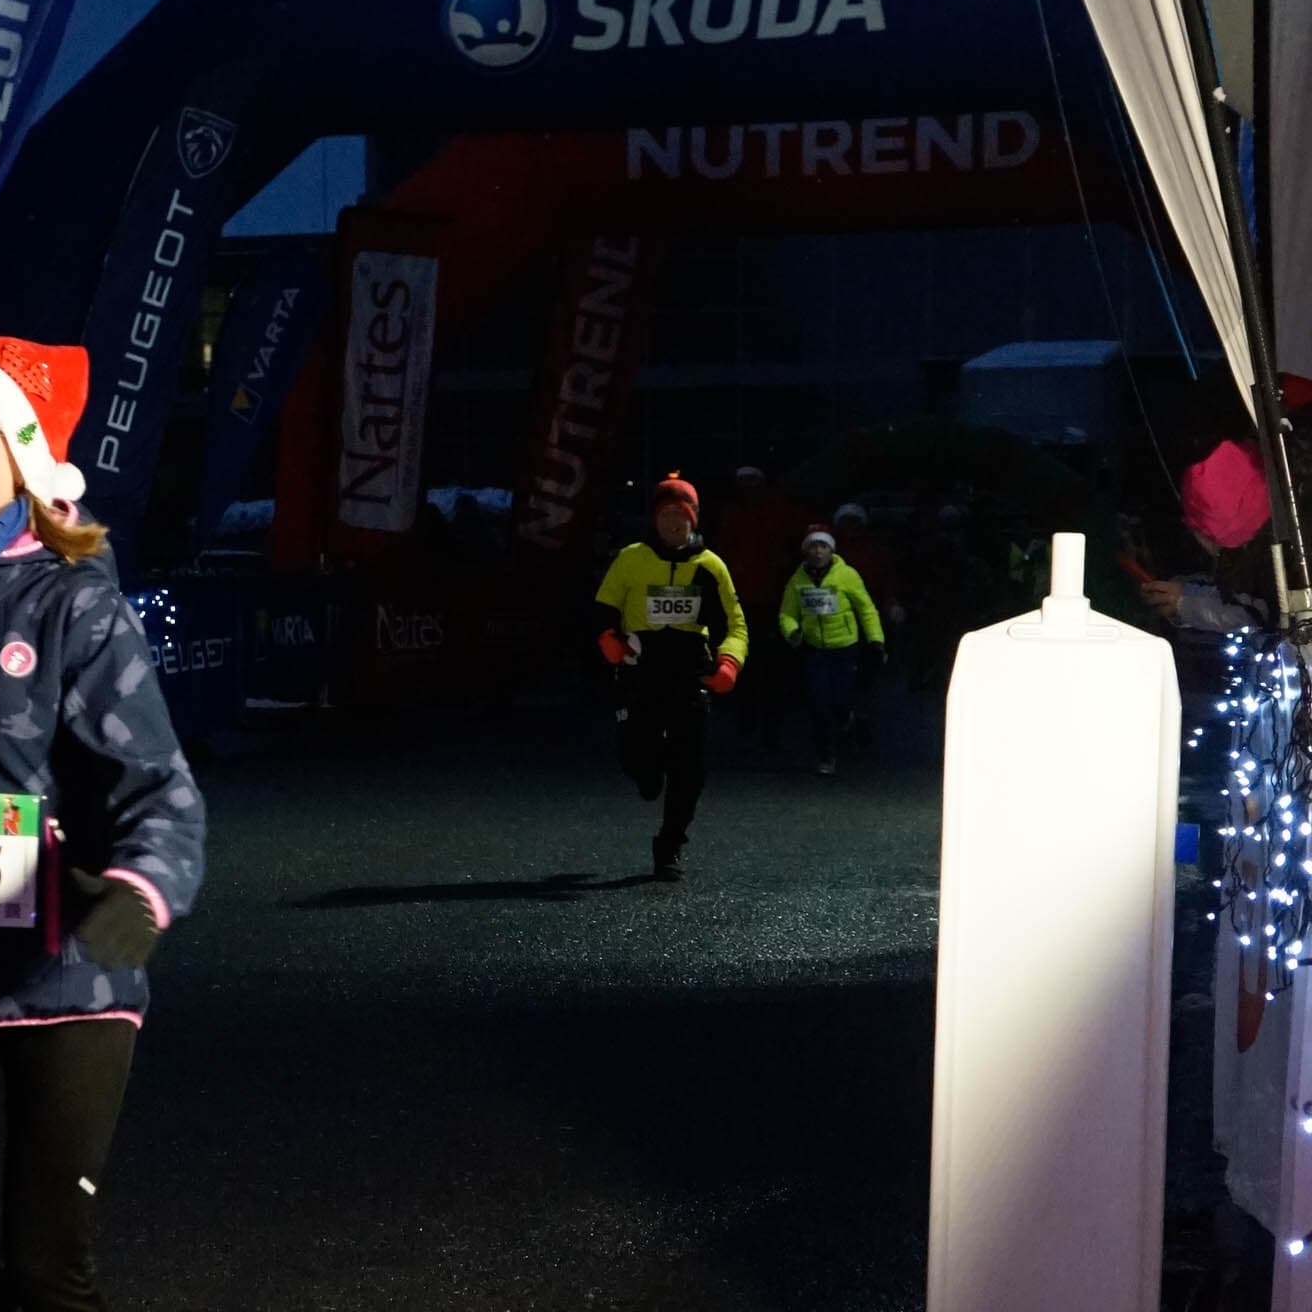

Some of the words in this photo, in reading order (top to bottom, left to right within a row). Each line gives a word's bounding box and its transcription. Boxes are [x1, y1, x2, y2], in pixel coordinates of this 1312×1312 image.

[624, 108, 1042, 181] NUTREND
[95, 186, 196, 475] PEUGEOT
[247, 287, 302, 380] VARTA
[341, 279, 411, 505] Nartes
[652, 599, 693, 614] 3065
